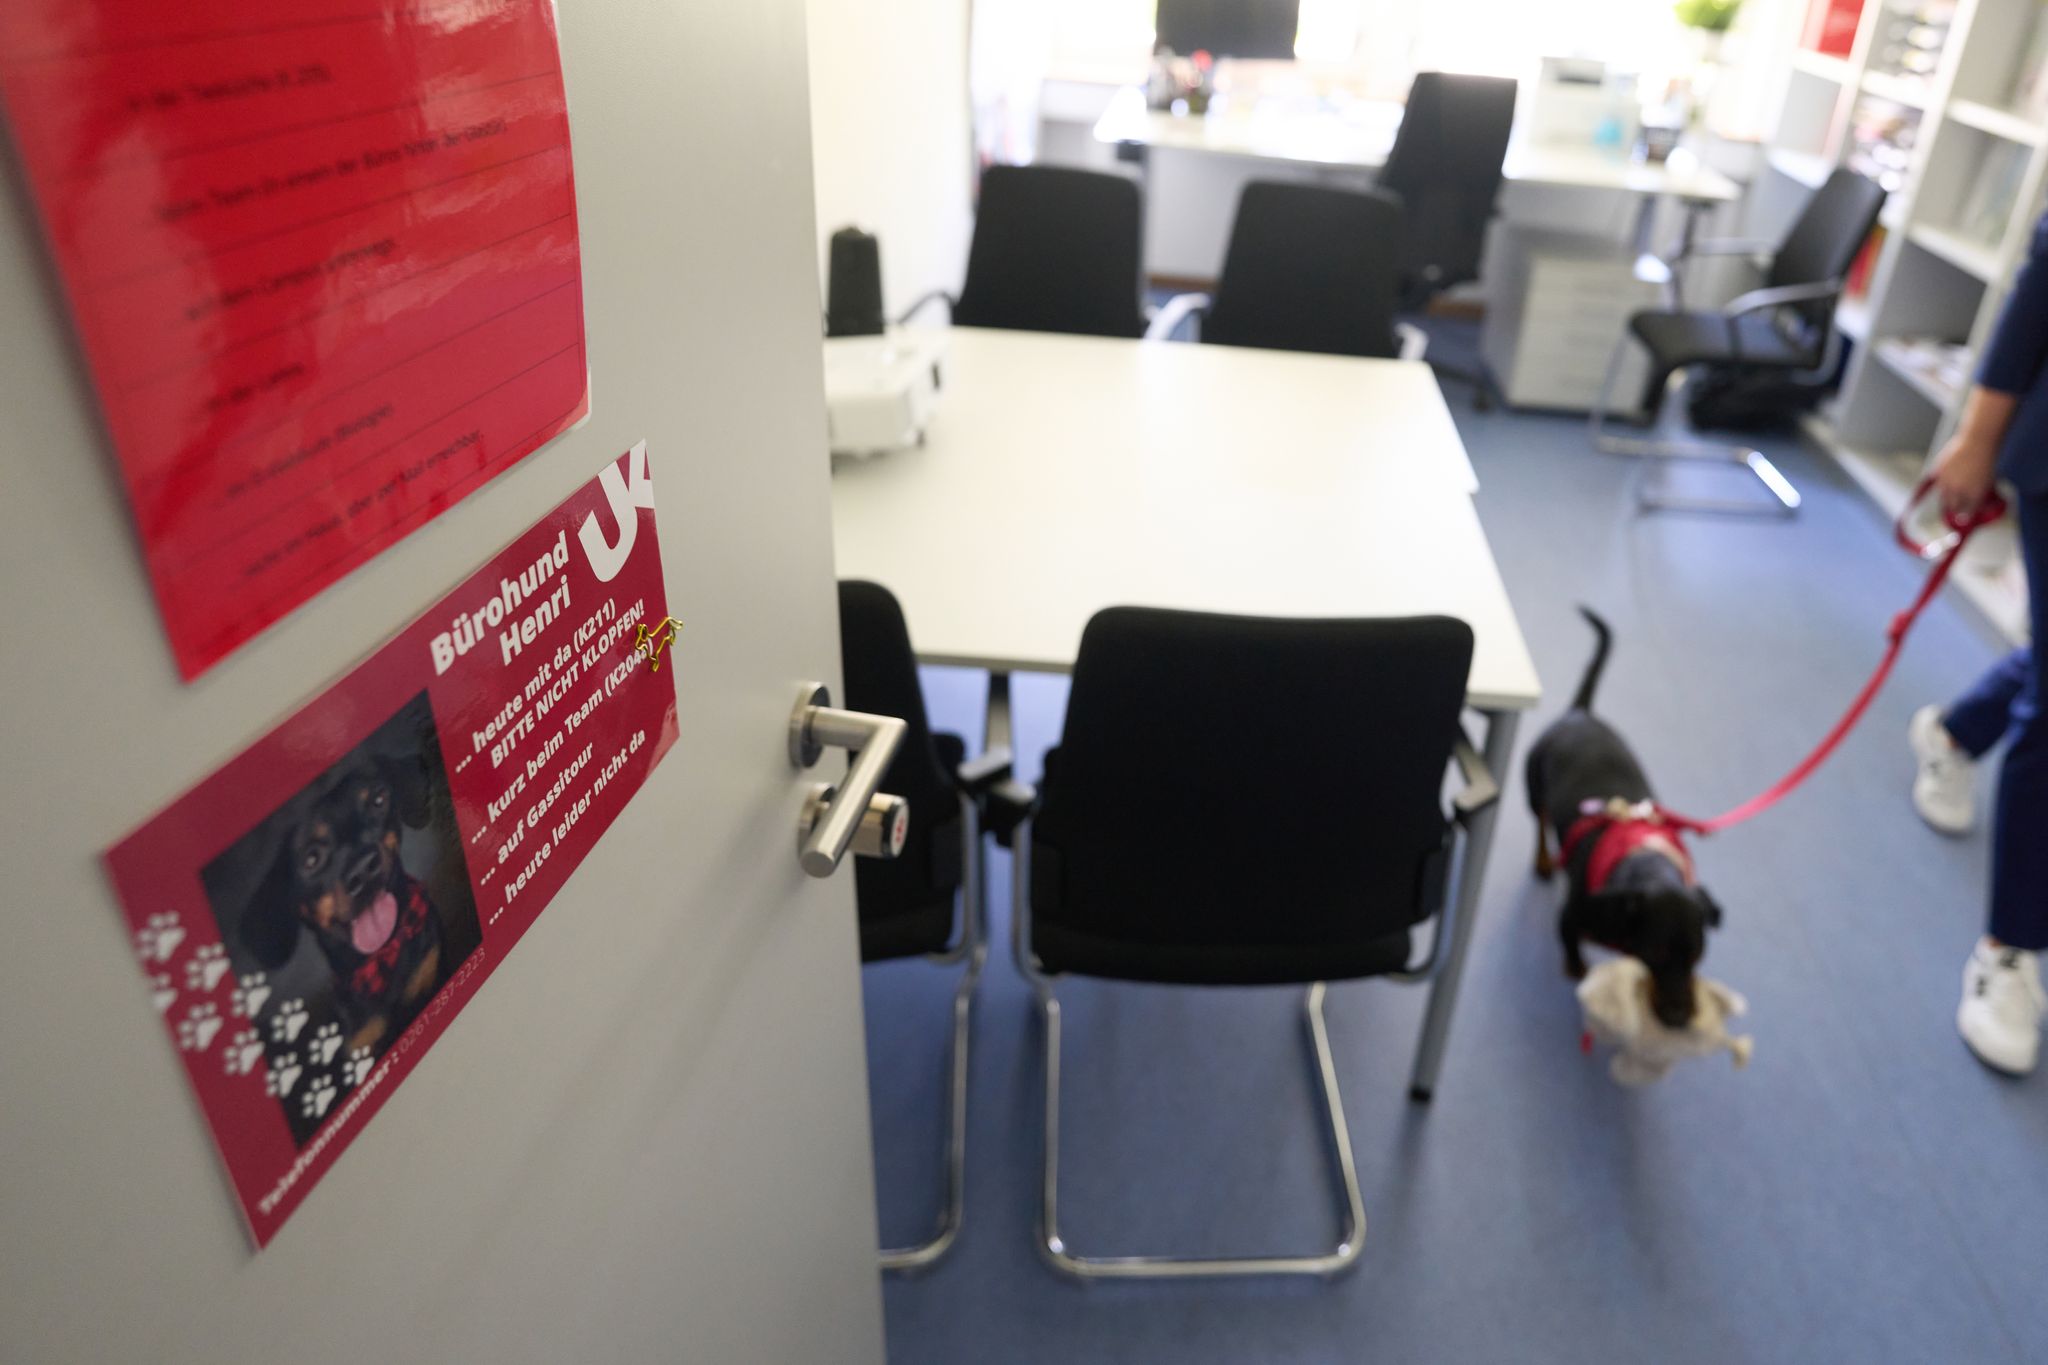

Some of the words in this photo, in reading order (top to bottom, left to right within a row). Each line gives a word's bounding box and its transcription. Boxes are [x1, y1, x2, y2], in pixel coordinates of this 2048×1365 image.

[430, 529, 569, 676] Bürohund
[472, 694, 523, 753] heute
[524, 662, 552, 701] mit
[553, 644, 572, 671] da
[573, 597, 616, 654] (K211)
[499, 574, 571, 667] Henri
[487, 773, 527, 824] kurz
[526, 730, 564, 781] beim
[564, 688, 604, 735] Team
[490, 710, 535, 769] BITTE
[536, 660, 579, 722] NICHT
[581, 598, 645, 674] KLOPFEN!
[497, 818, 525, 865] auf
[526, 742, 593, 828] Gassitour
[504, 842, 552, 904] heute
[551, 789, 592, 848] leider
[593, 748, 628, 796] nicht
[629, 729, 646, 754] da
